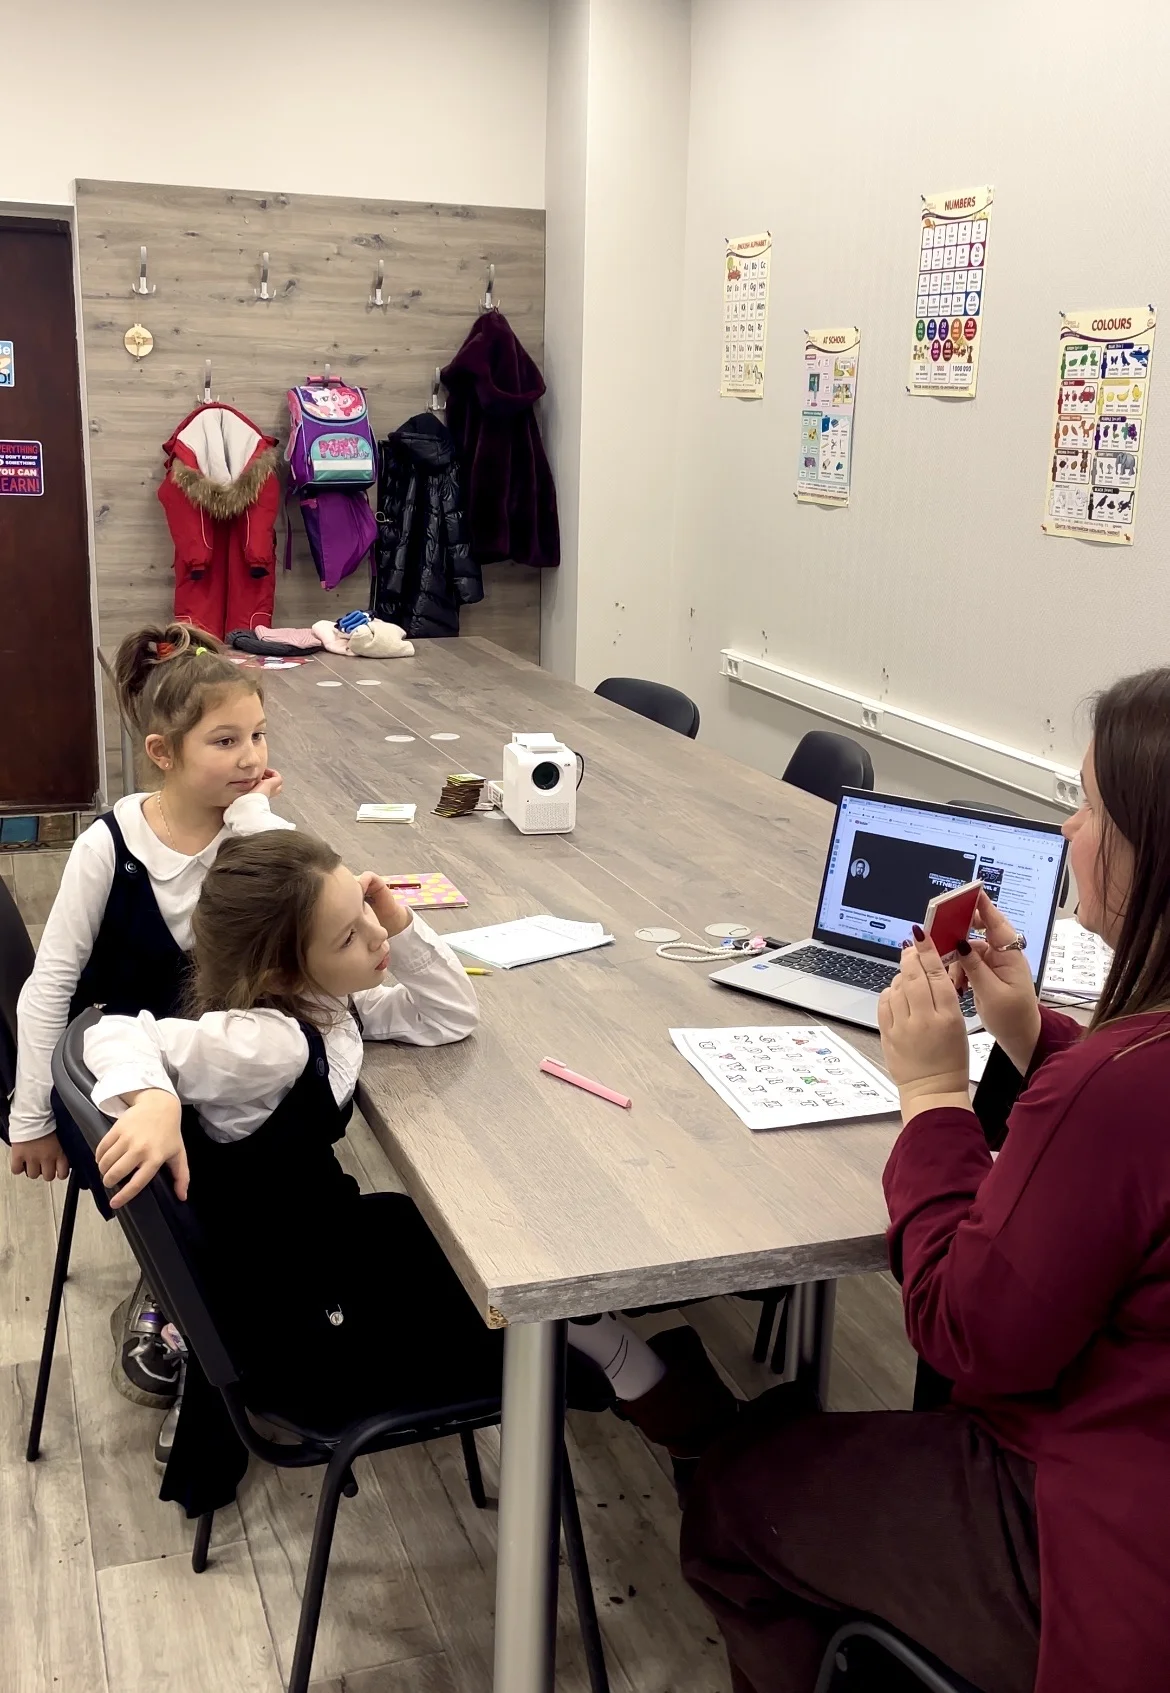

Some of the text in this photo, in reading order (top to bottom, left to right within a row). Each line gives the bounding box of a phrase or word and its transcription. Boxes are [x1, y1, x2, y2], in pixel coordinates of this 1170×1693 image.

[945, 196, 976, 211] NUMBERS
[1092, 317, 1132, 331] COLOURS
[823, 336, 828, 344] AT
[828, 336, 846, 344] SCHOOL
[0, 468, 37, 477] OU CAN
[0, 478, 40, 493] EARN!
